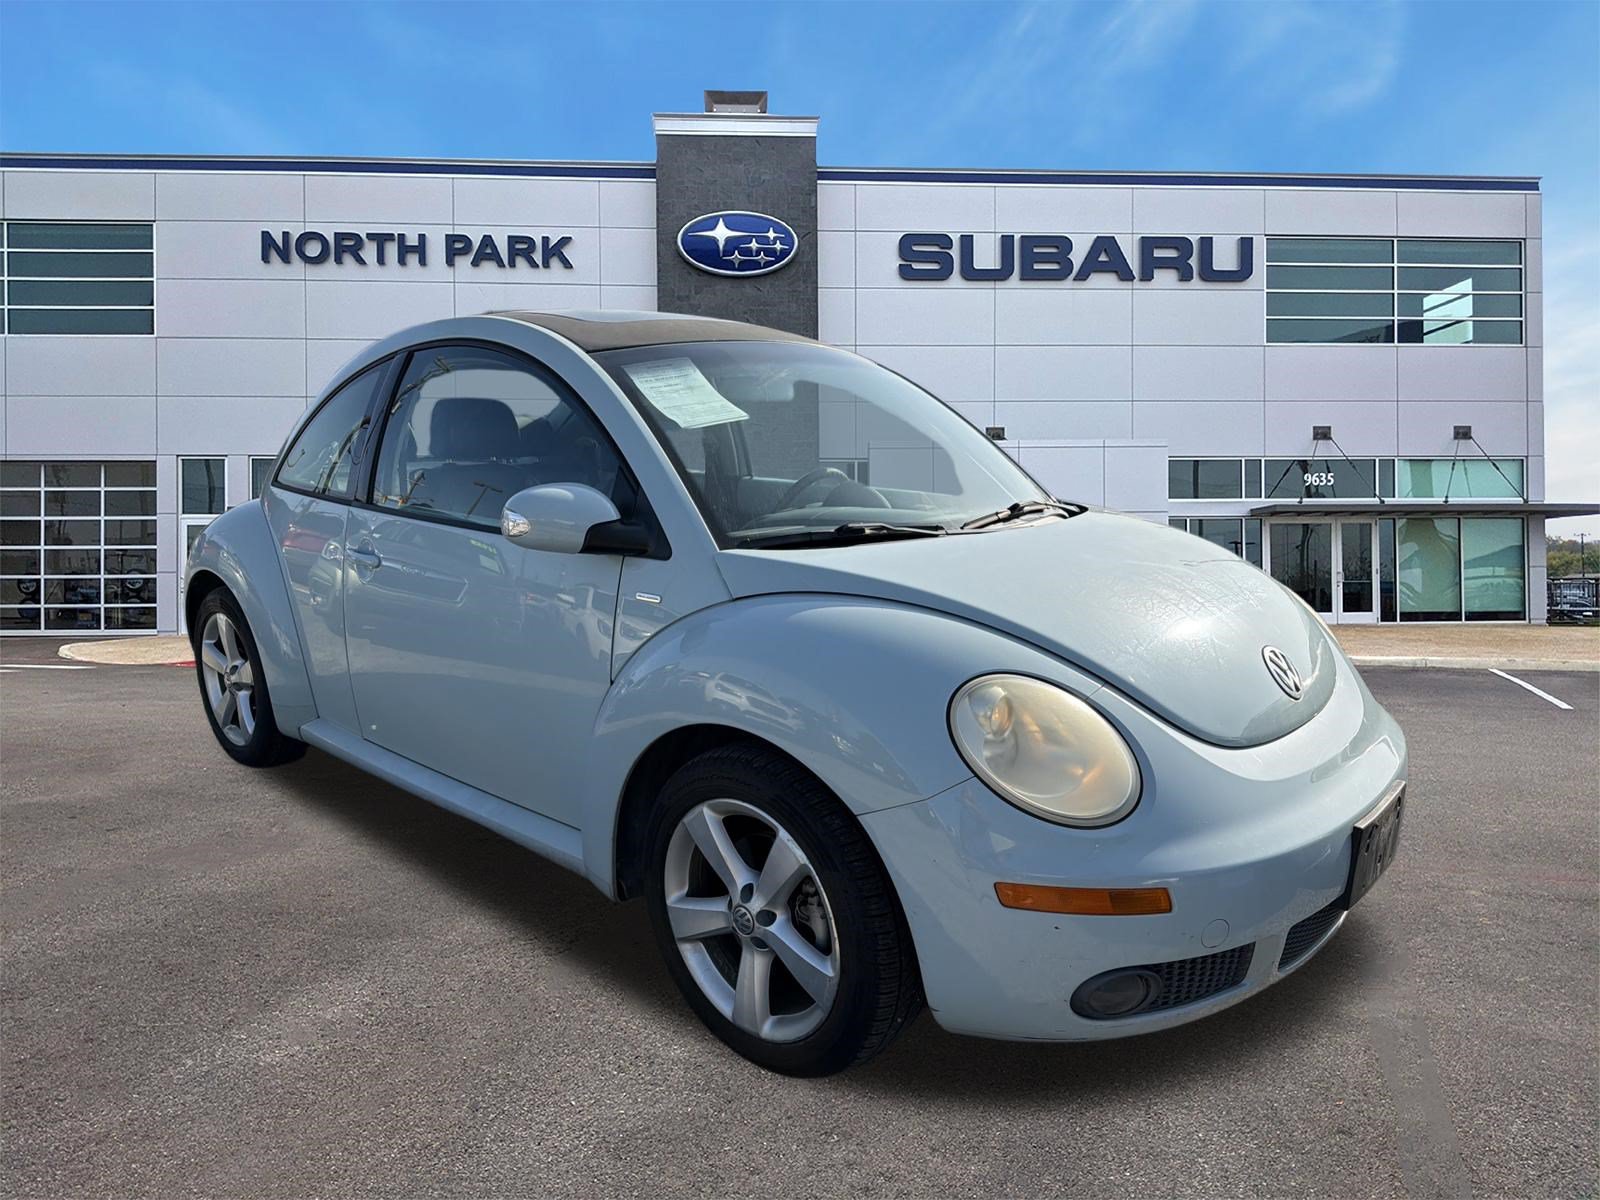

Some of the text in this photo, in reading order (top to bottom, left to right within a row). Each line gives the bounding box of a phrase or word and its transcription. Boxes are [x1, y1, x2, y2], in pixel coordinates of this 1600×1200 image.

[261, 230, 574, 268] NORTH PARK
[898, 233, 1254, 282] SUBARU
[1304, 473, 1335, 486] 9635
